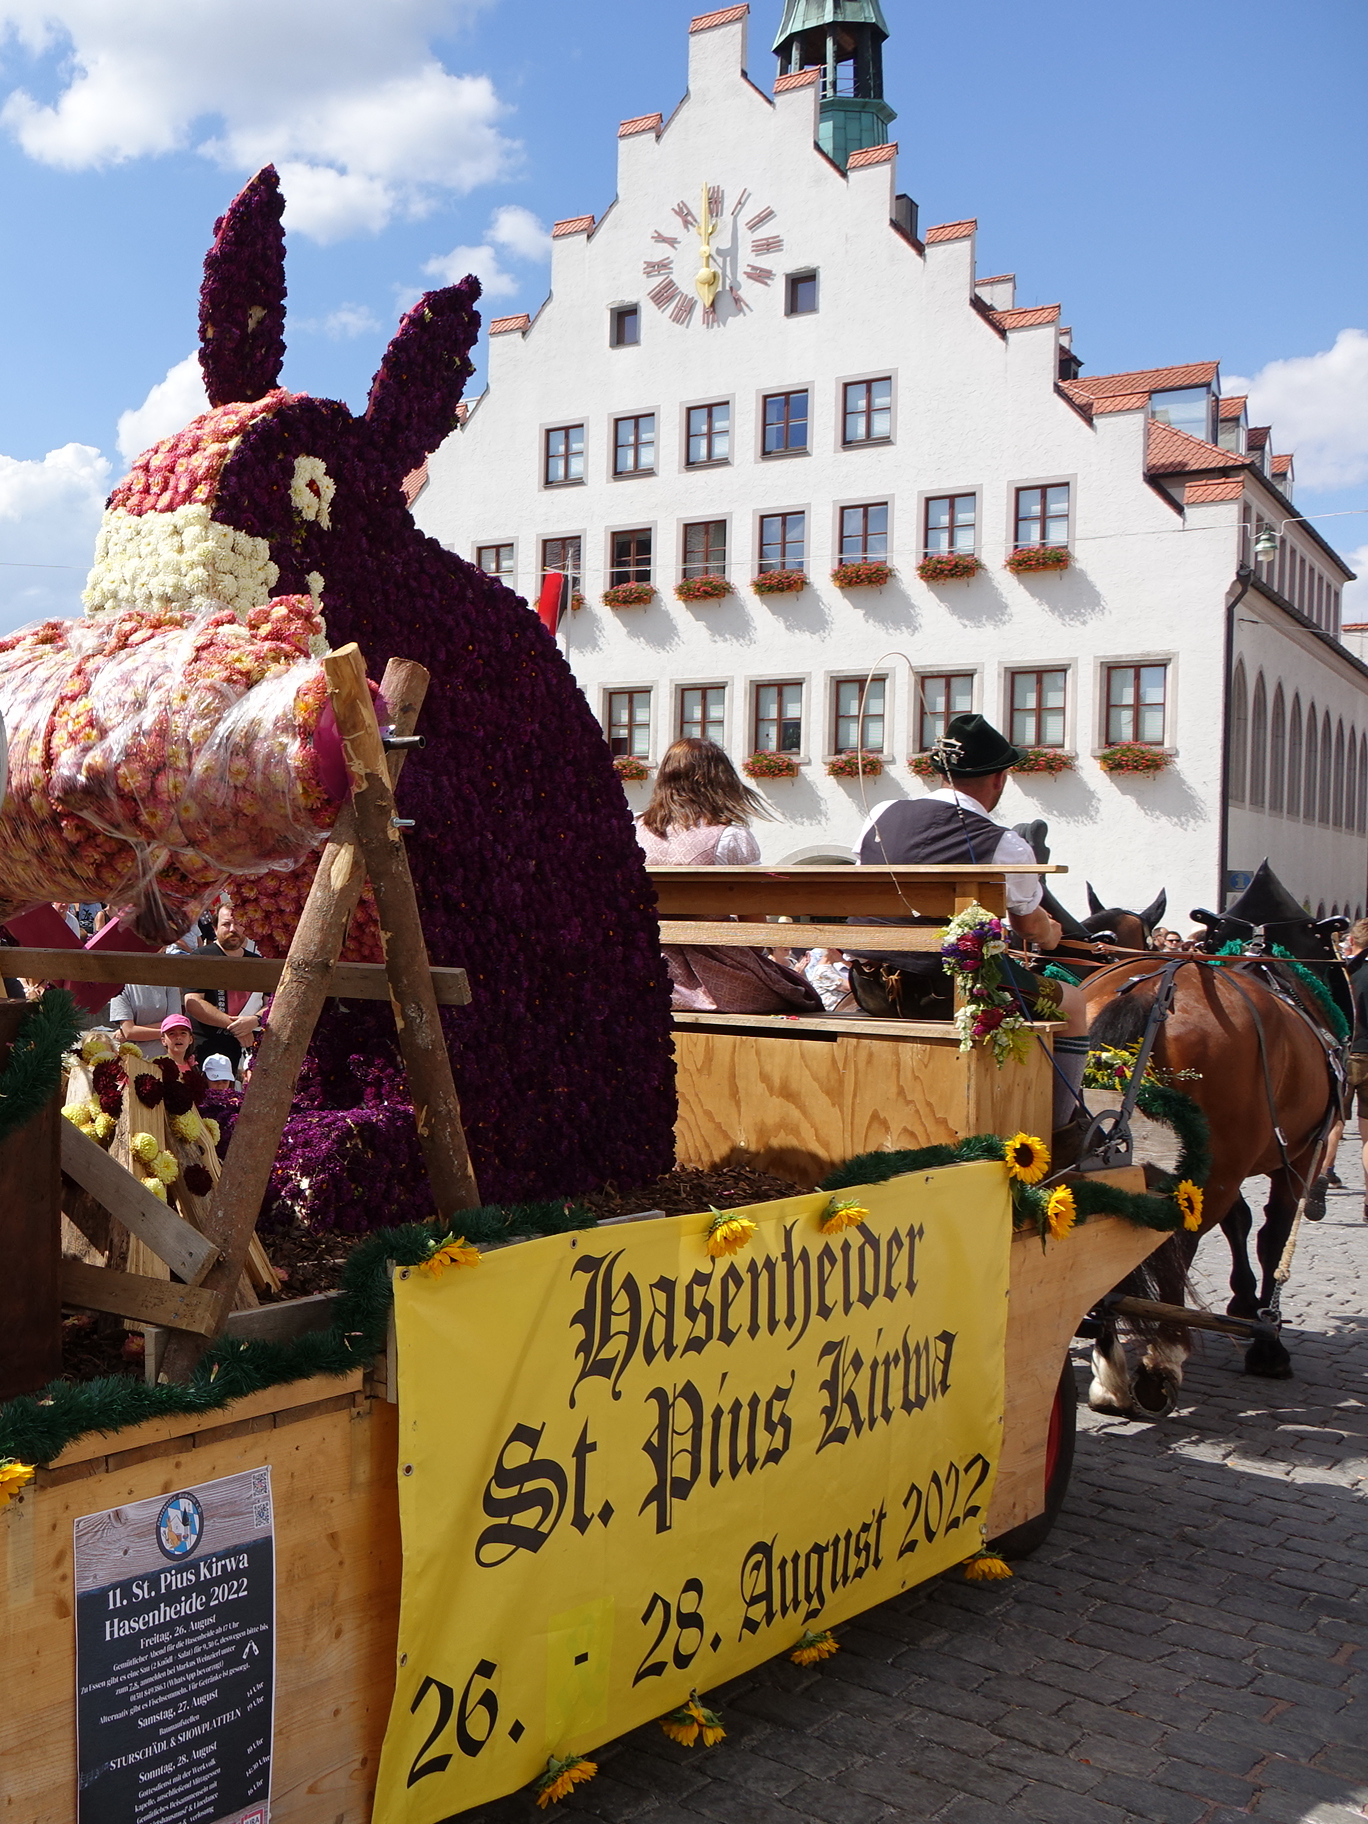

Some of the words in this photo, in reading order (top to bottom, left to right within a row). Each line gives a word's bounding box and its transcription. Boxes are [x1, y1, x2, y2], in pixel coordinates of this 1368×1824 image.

[569, 1219, 925, 1410] Hasenheider
[475, 1417, 615, 1569] St.
[638, 1370, 796, 1535] Pius
[816, 1328, 958, 1455] Kirwa
[105, 1592, 205, 1641] Hasenheide
[209, 1577, 247, 1606] 2022
[107, 1587, 127, 1609] 11.
[132, 1580, 155, 1602] St.
[159, 1569, 195, 1593] Pius
[199, 1553, 248, 1581] Kirwa
[140, 1631, 172, 1648] Freitag,
[173, 1624, 186, 1636] 26.
[188, 1614, 215, 1631] August
[407, 1659, 526, 1790] 26.
[632, 1577, 722, 1689] 28.
[738, 1494, 887, 1643] August
[897, 1453, 991, 1562] 2022
[137, 1708, 175, 1728] Samstag,
[177, 1700, 189, 1713] 27.
[192, 1688, 217, 1706] August
[158, 1714, 199, 1735] Baumaufstellen
[109, 1740, 168, 1770] STURSCHÄDL
[169, 1736, 176, 1747] &
[177, 1708, 240, 1743] SHOWPLATTELN
[138, 1762, 175, 1783] Sonntag,
[176, 1754, 188, 1766] 28.
[192, 1740, 216, 1759] August
